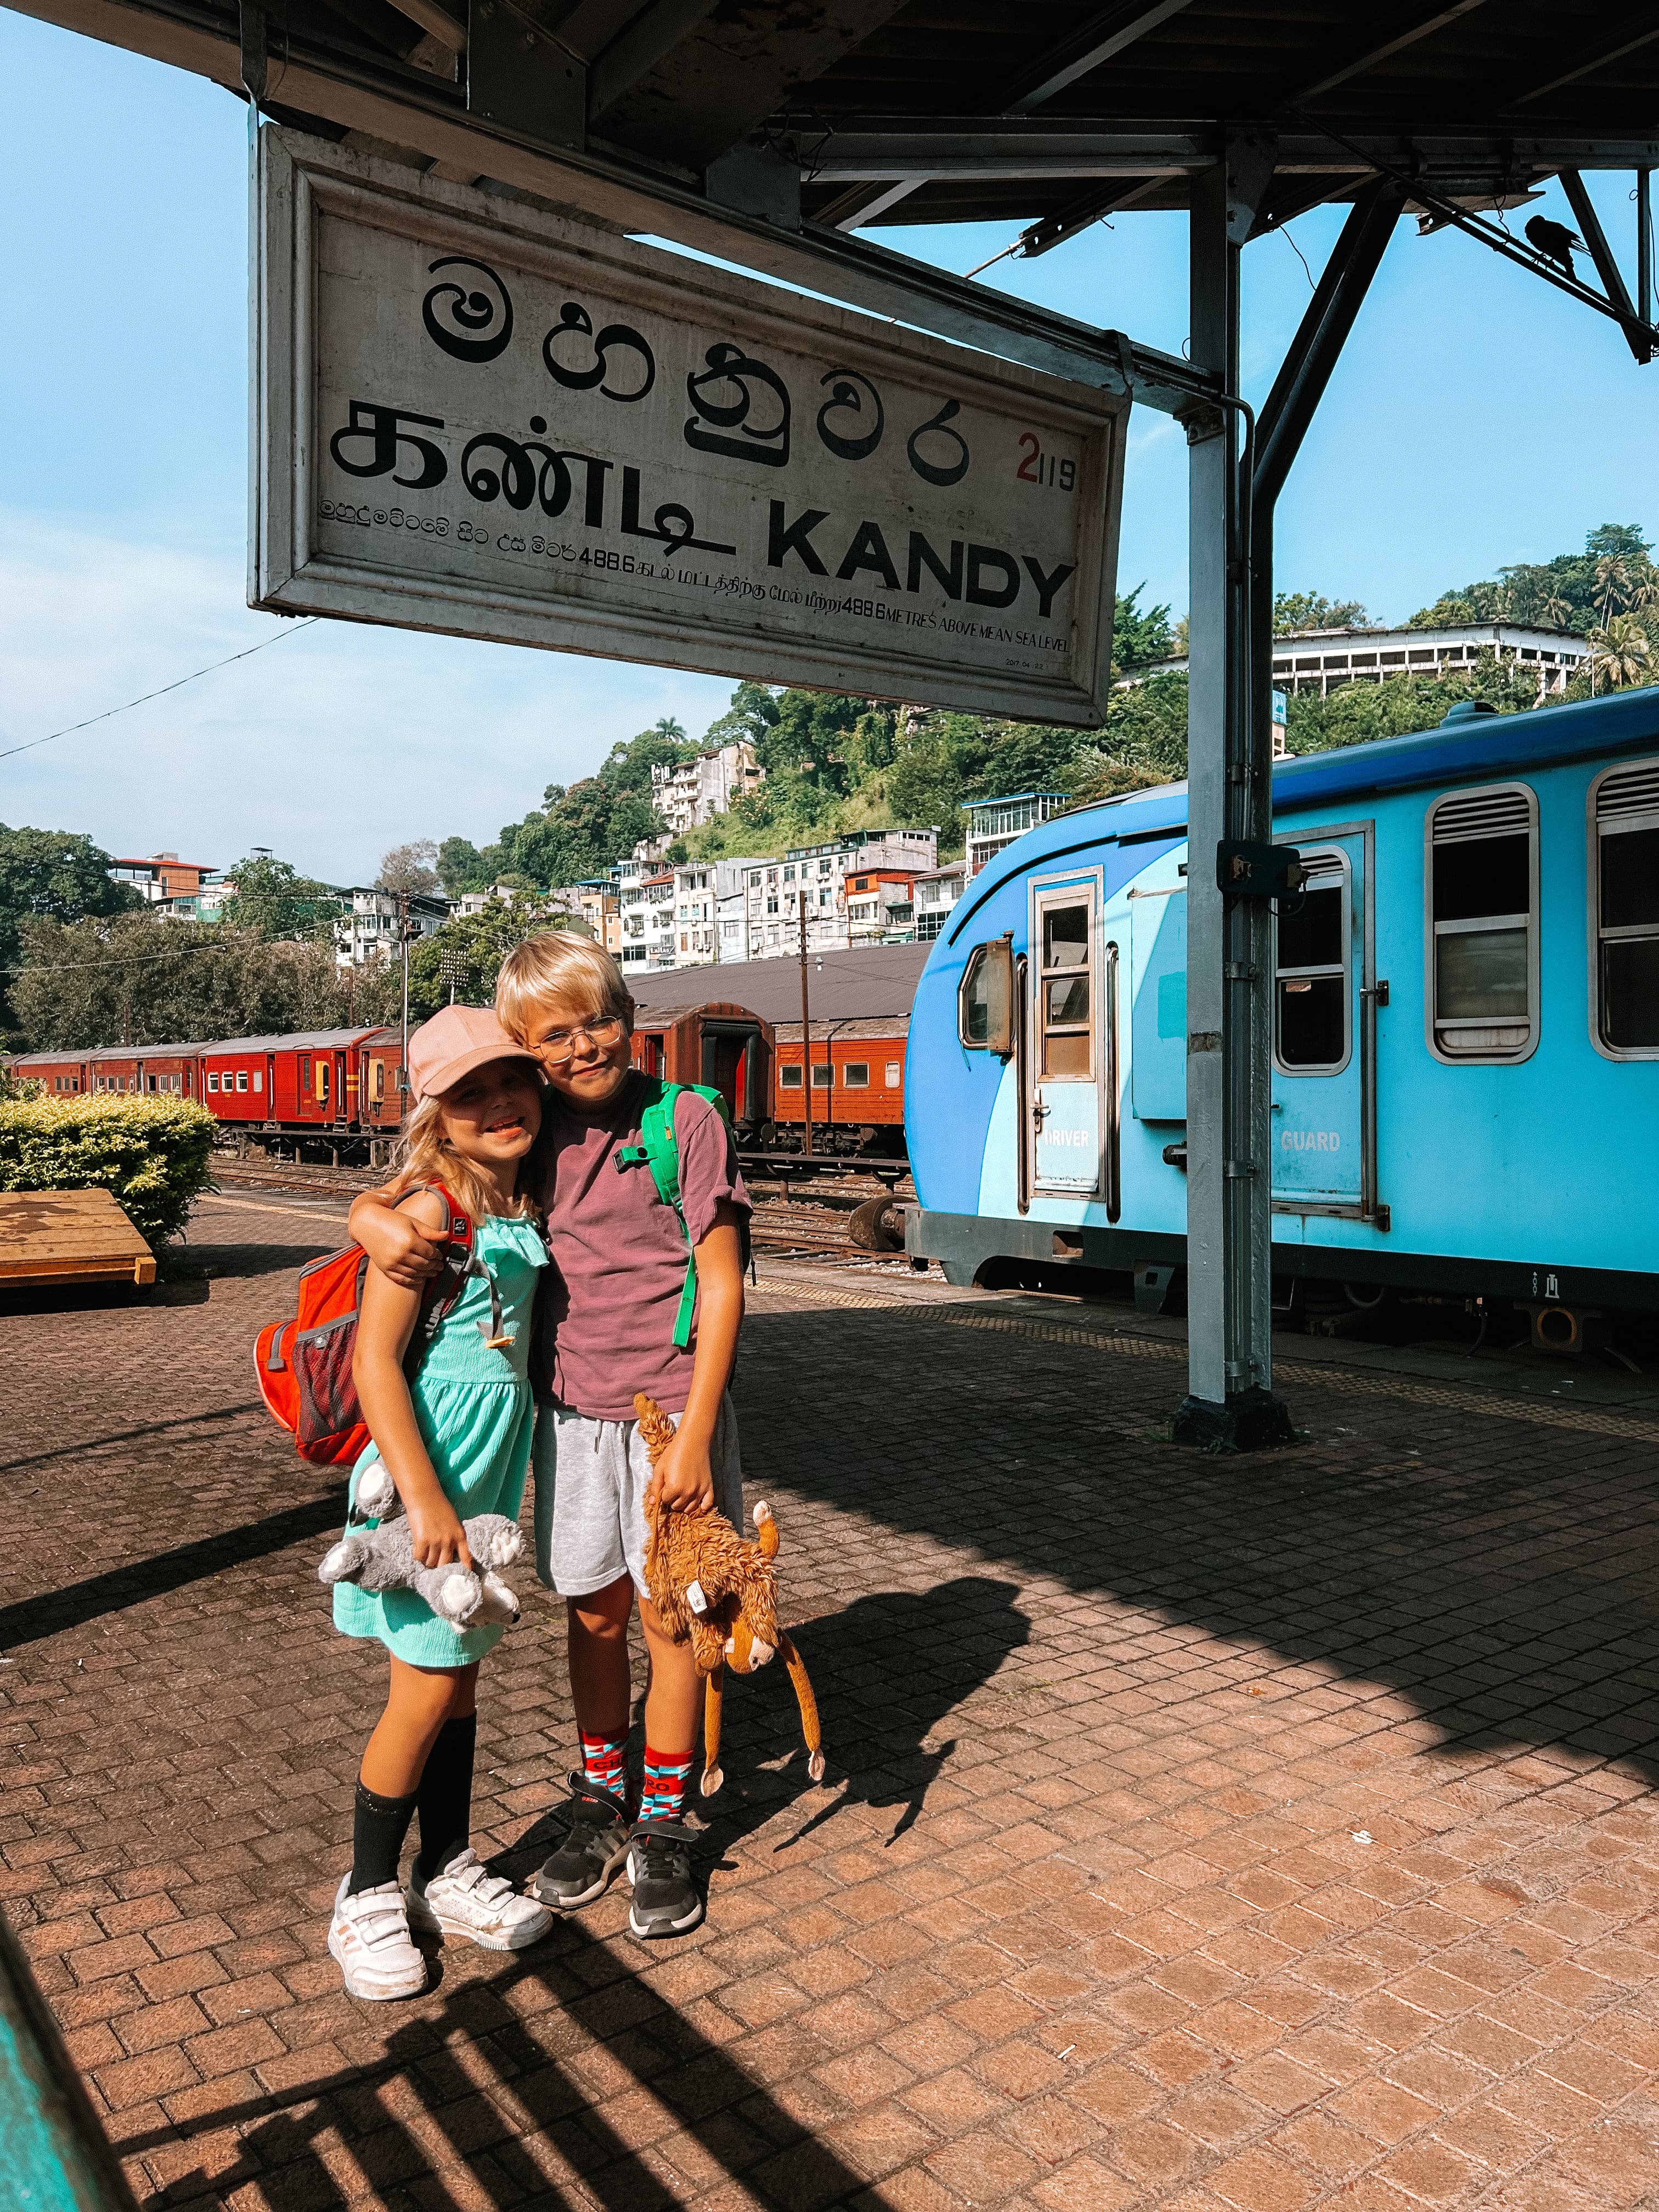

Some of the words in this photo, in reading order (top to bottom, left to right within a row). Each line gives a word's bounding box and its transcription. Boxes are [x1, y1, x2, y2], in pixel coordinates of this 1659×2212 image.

[422, 255, 969, 487] මහනුවර
[330, 398, 736, 557] கண்டி
[579, 547, 635, 574] 488.6
[767, 499, 1075, 618] KANDY
[769, 585, 803, 604] மேல்
[841, 596, 885, 620] 488.6
[885, 607, 937, 629] METRES
[938, 617, 979, 637] ABOVE
[979, 624, 1013, 643] MEAN
[1015, 631, 1036, 647] SEA
[1038, 635, 1071, 653] LEVEL
[1045, 1129, 1089, 1147] DRIVER
[1281, 1130, 1341, 1152] GUARD
